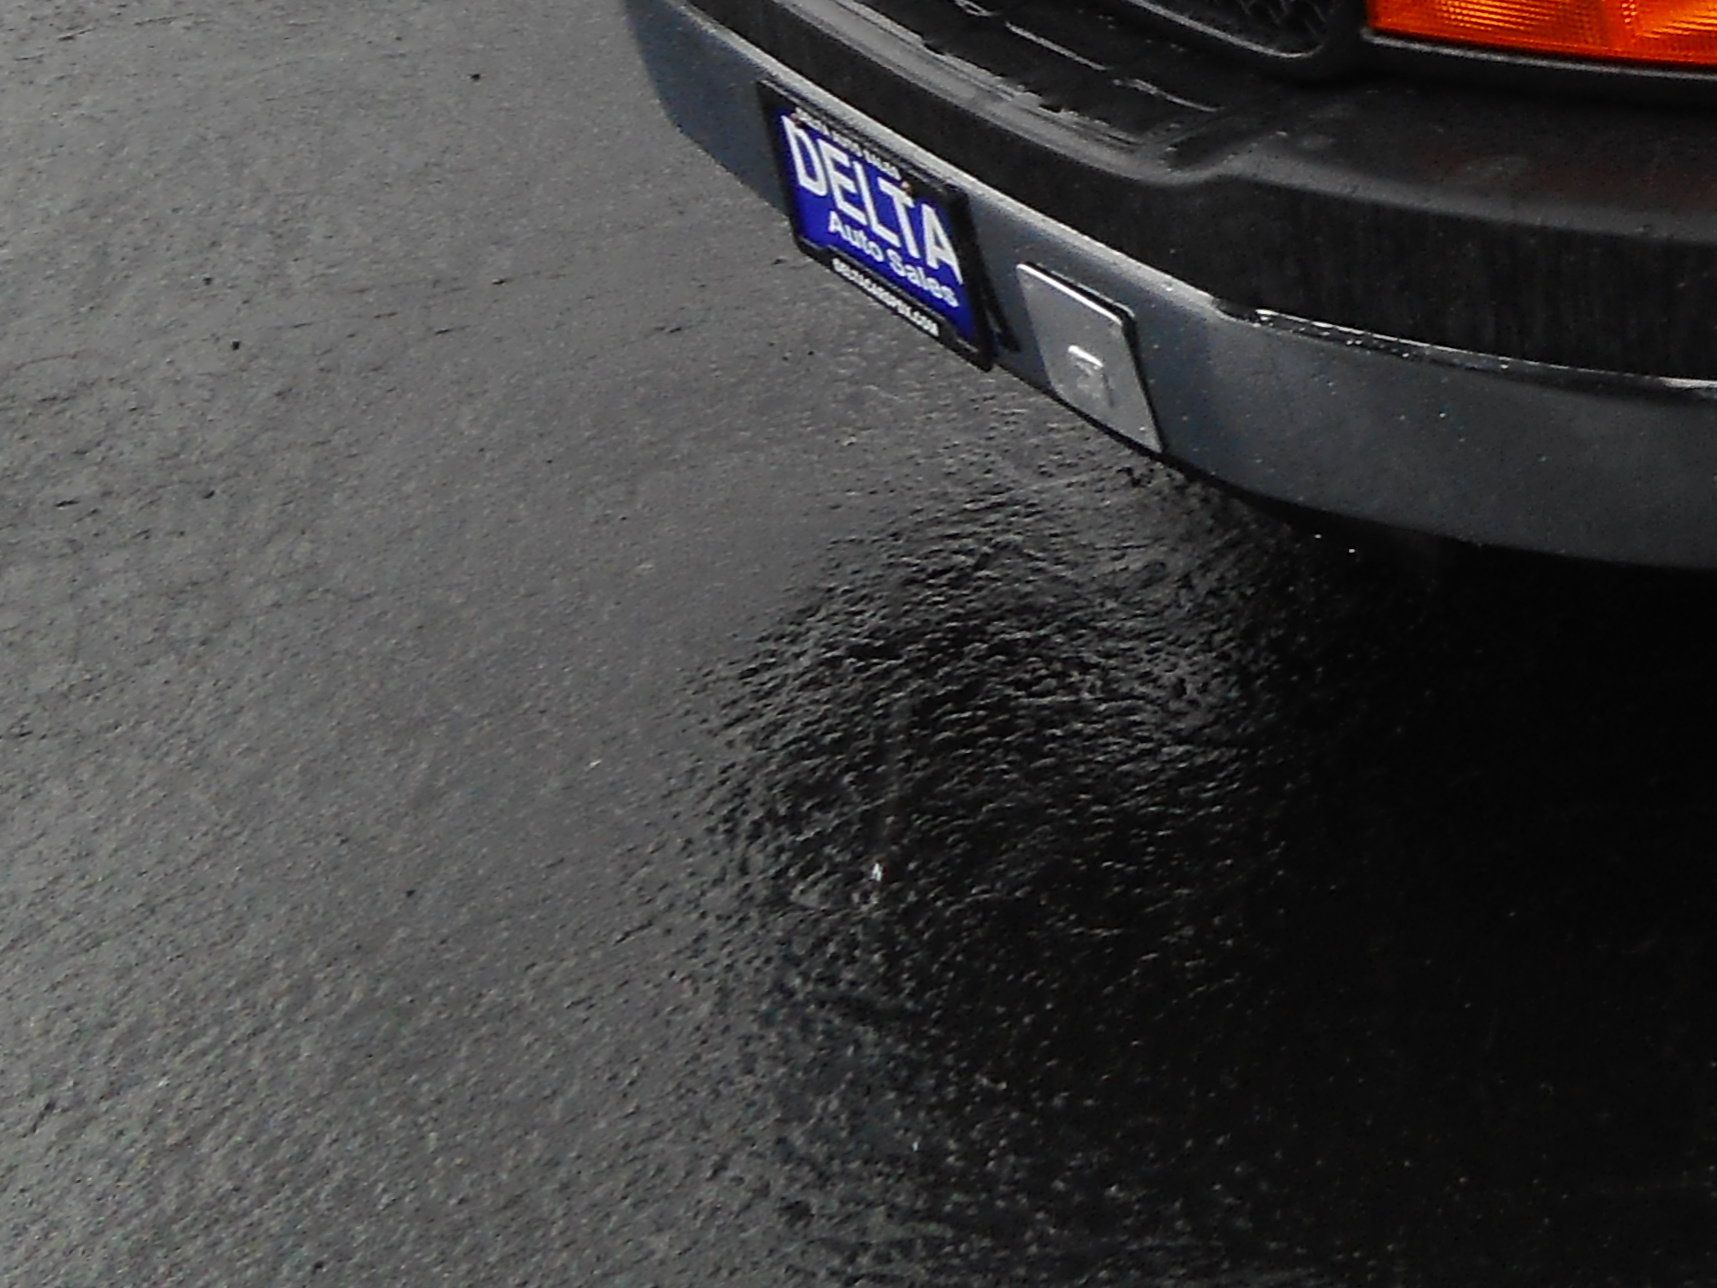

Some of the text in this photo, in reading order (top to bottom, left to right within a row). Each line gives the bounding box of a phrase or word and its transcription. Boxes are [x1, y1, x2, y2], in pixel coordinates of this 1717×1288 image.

[781, 115, 964, 285] DELTA
[828, 211, 885, 263] Auto
[886, 249, 960, 308] Sales
